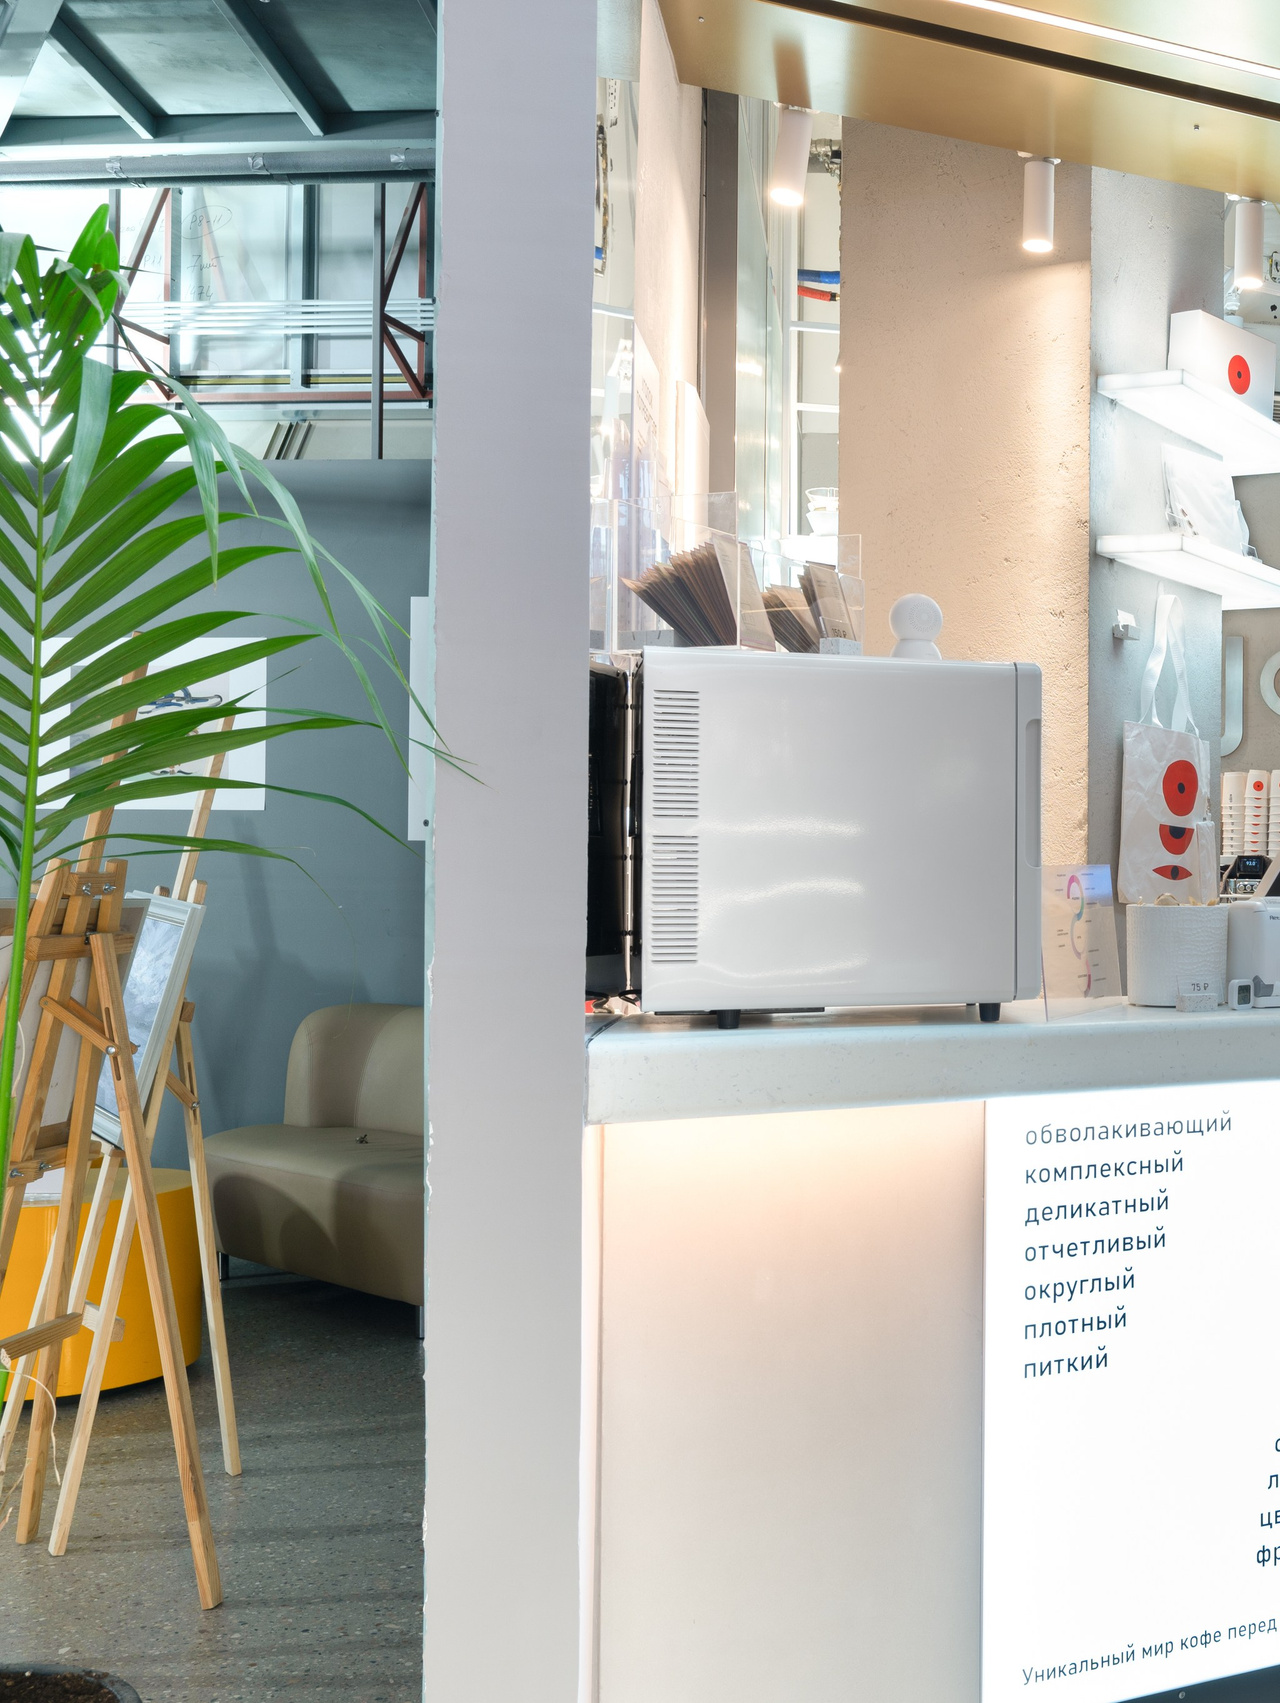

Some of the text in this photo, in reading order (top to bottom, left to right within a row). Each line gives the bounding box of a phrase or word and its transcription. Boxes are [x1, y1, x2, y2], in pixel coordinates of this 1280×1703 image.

[1191, 983, 1201, 991] 75
[1026, 1110, 1232, 1145] обволакивающий
[1025, 1150, 1183, 1184] комплексный
[1025, 1188, 1169, 1226] деликатный
[1025, 1226, 1166, 1262] отчетливый
[1025, 1266, 1135, 1303] округлый
[1025, 1305, 1127, 1340] плотный
[1025, 1345, 1108, 1378] питкий
[1023, 1643, 1134, 1685] Уникальный
[1142, 1641, 1173, 1659] мир
[1181, 1630, 1221, 1650] кофе
[1229, 1619, 1277, 1639] перед
